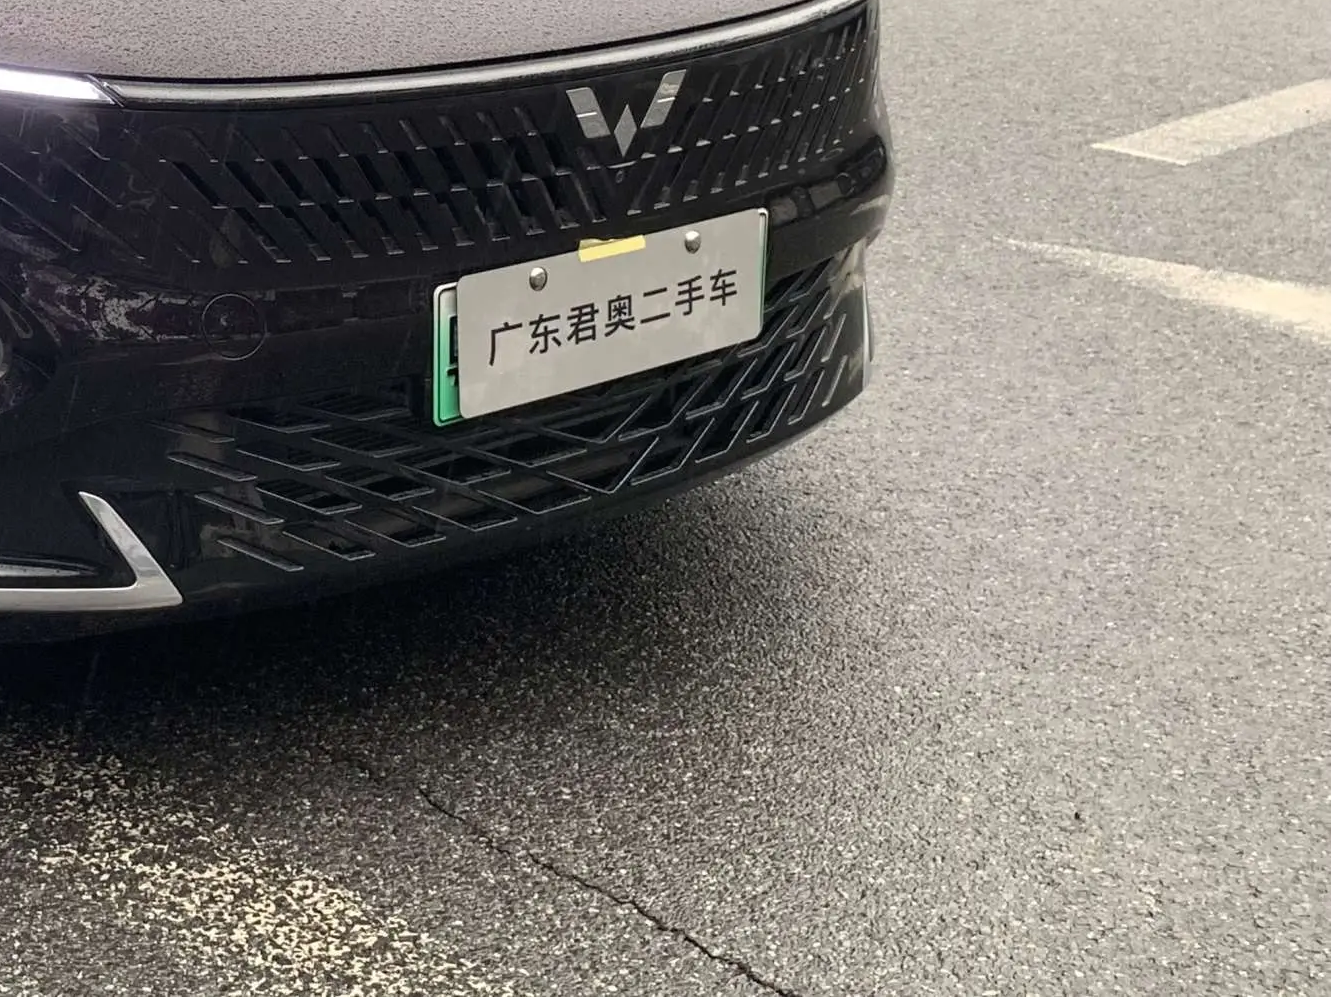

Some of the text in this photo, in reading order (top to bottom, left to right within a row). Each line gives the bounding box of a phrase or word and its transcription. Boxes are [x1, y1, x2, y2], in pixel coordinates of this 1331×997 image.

[488, 268, 738, 367] 广东君奥二手车
